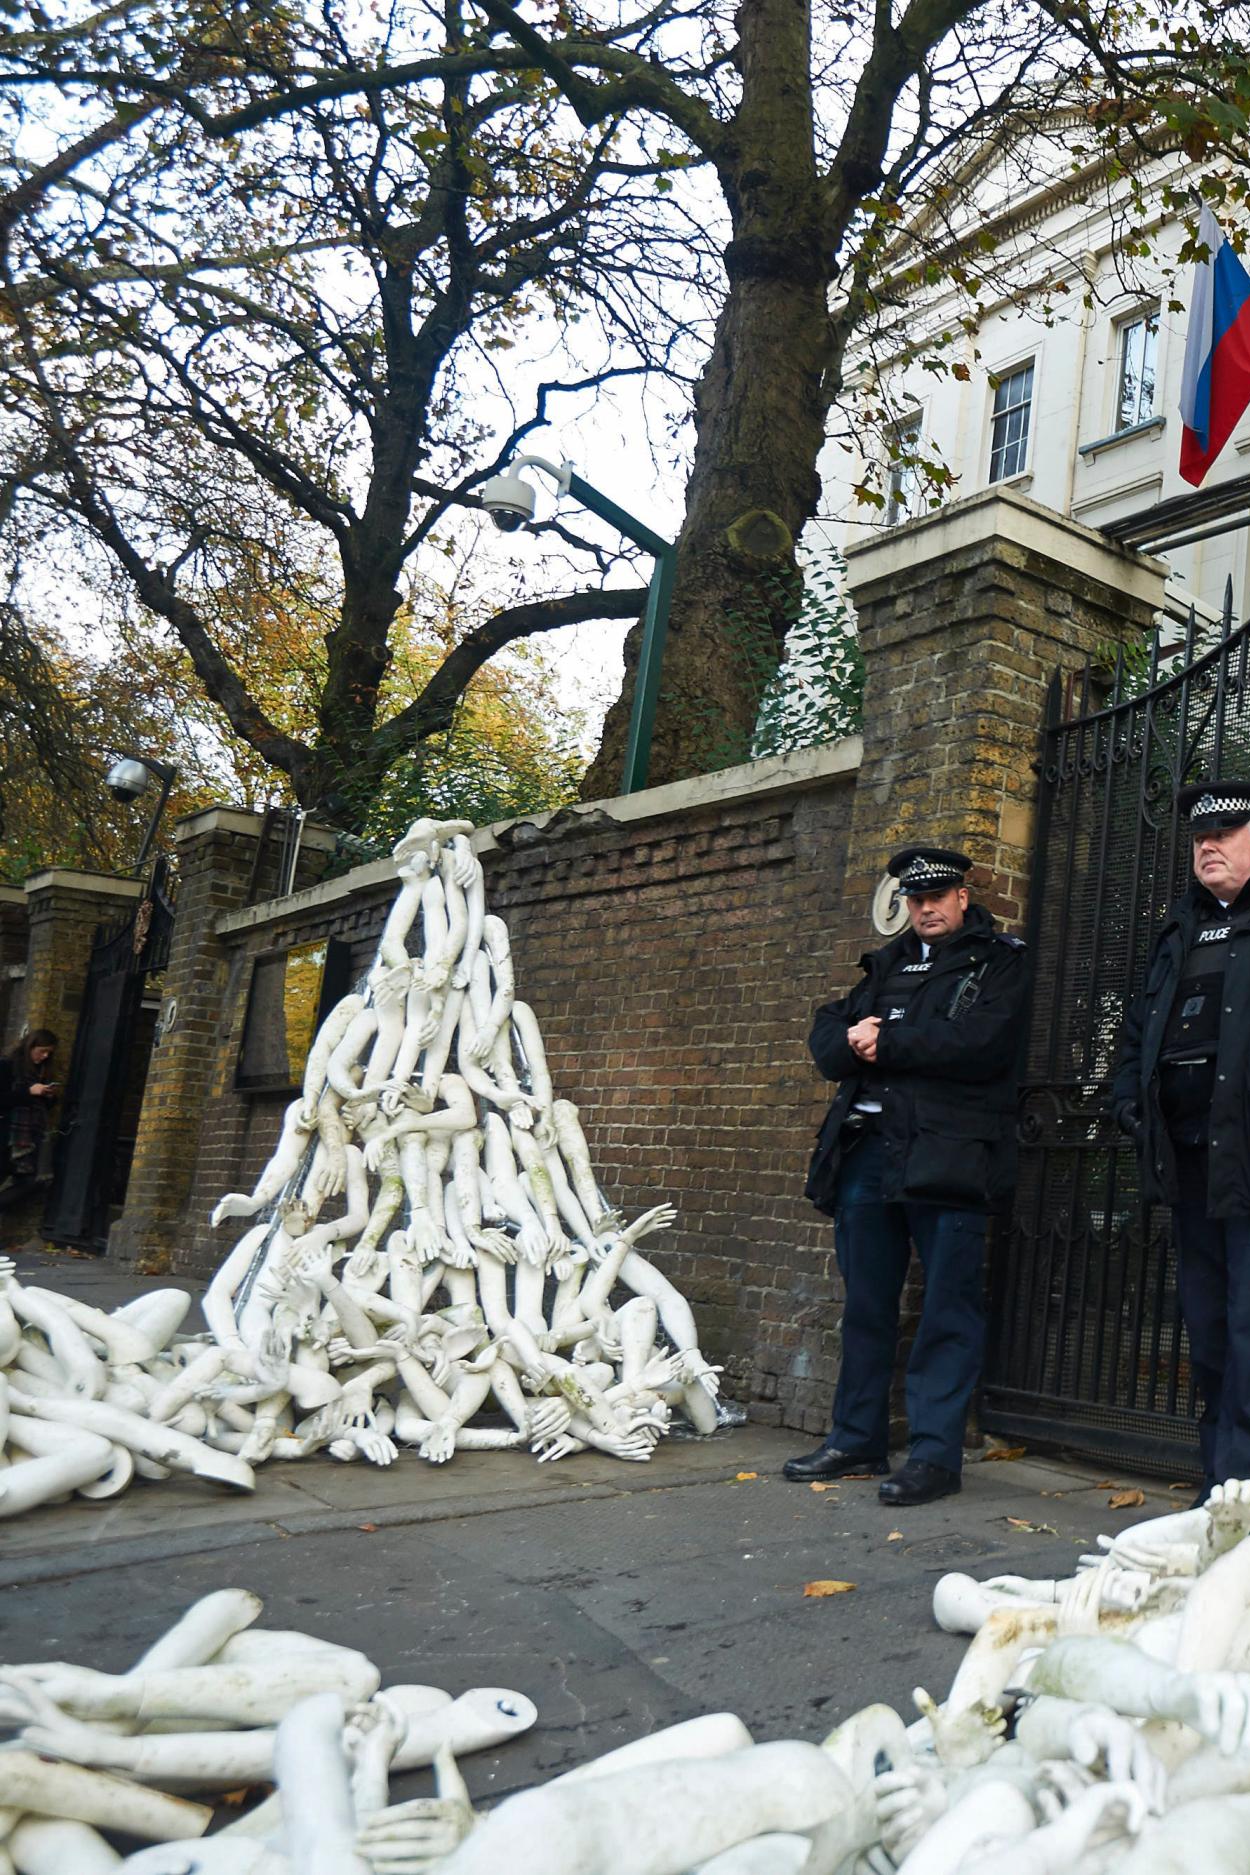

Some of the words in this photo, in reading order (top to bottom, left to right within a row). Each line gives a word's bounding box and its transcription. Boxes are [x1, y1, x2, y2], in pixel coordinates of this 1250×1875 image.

[886, 889, 900, 921] 5
[1199, 927, 1231, 942] POLICE
[902, 962, 932, 972] POLICE
